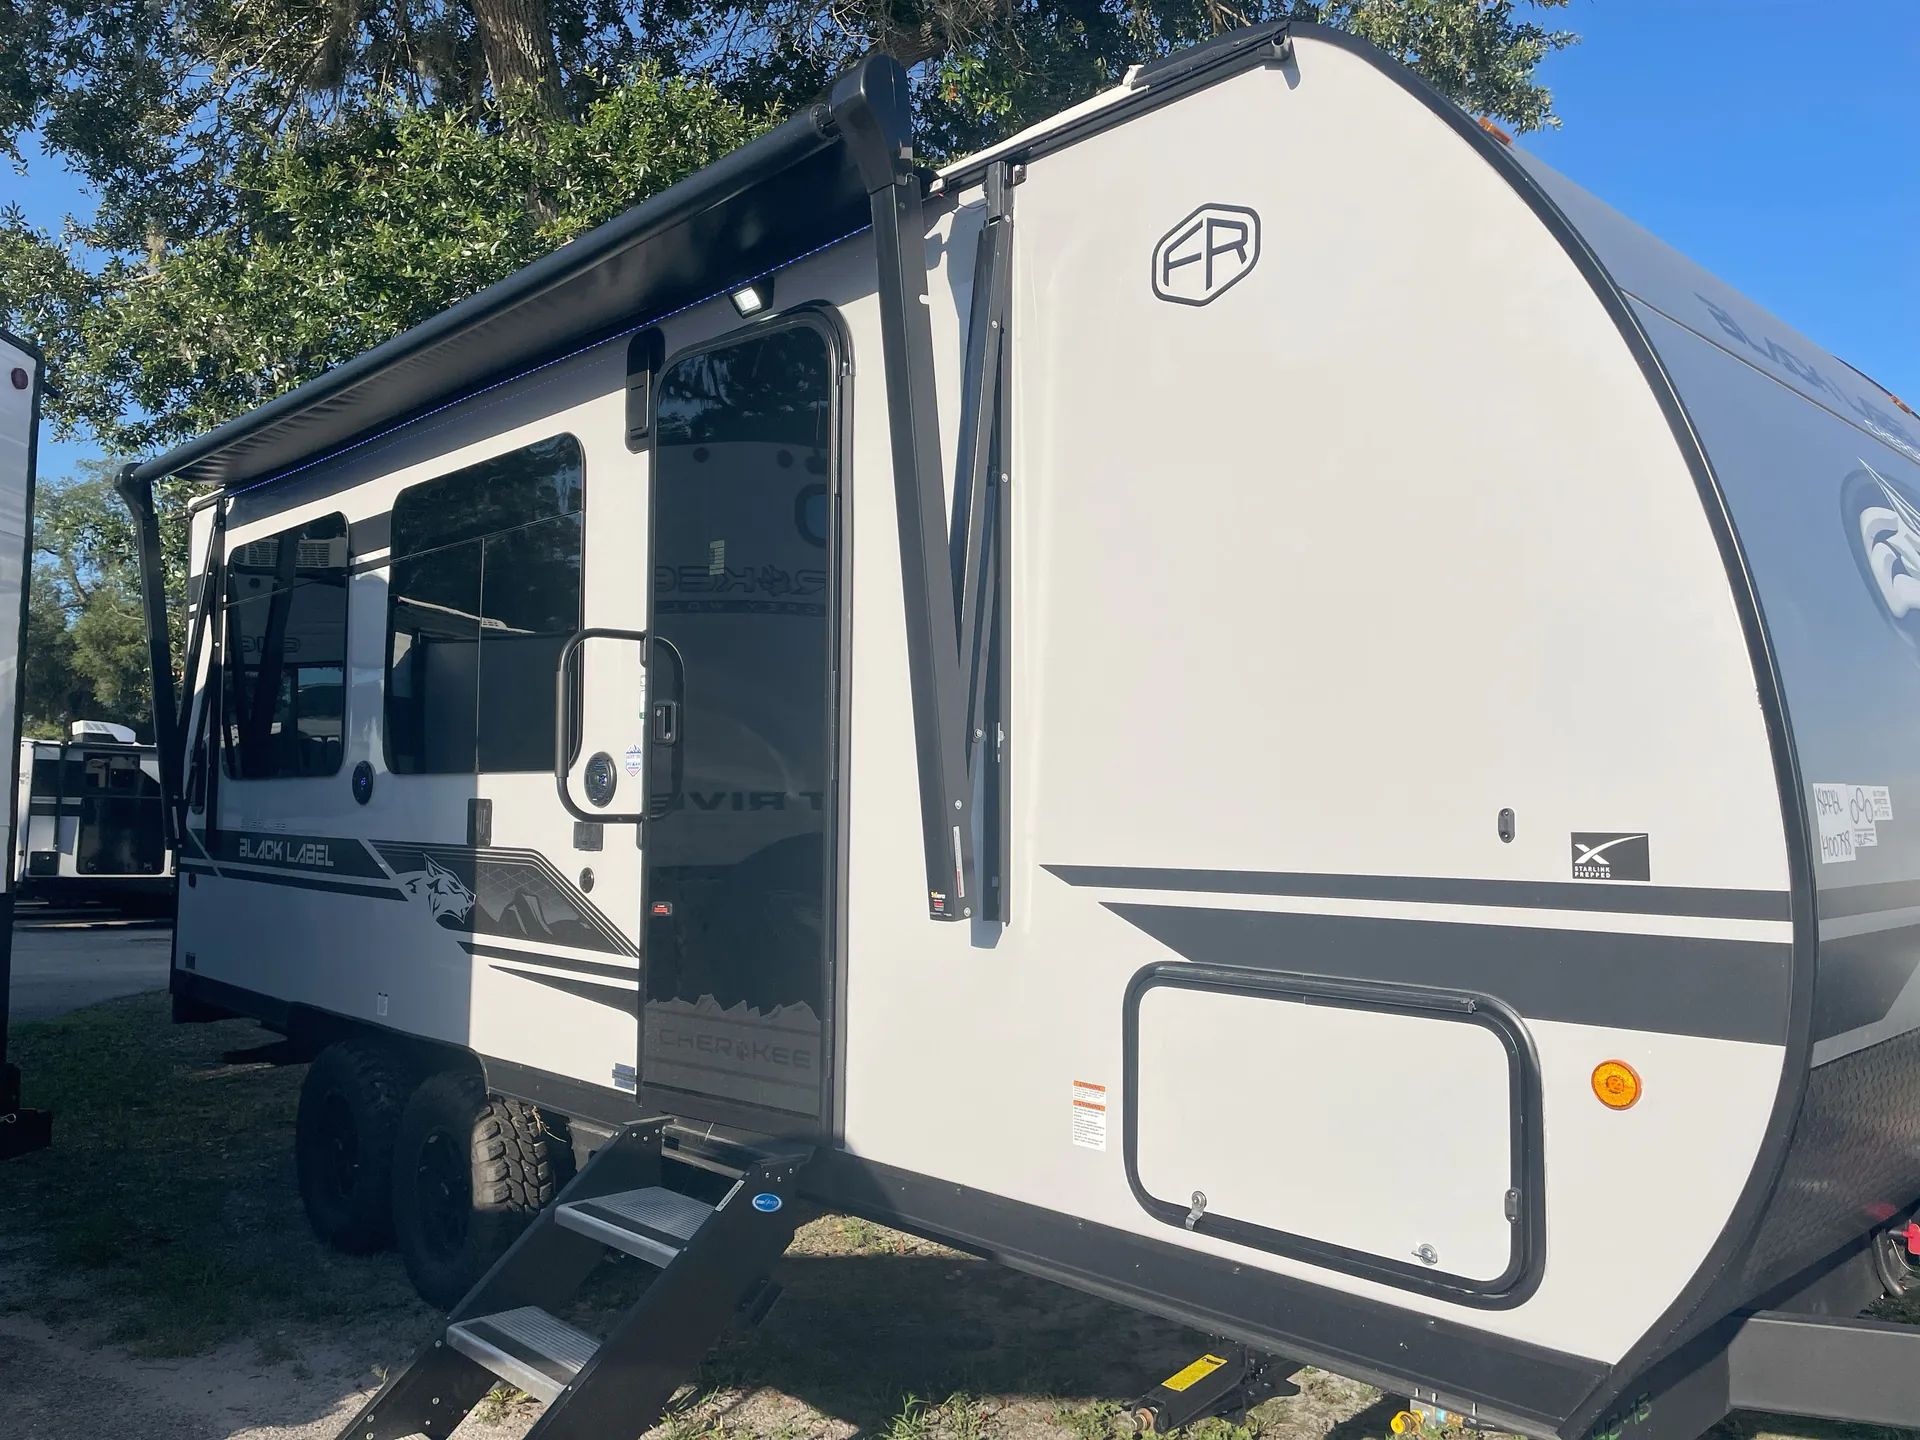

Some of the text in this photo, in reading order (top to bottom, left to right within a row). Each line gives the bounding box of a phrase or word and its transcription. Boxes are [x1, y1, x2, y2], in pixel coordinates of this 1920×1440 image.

[239, 838, 335, 867] BLACK LABEL
[1574, 865, 1611, 873] STARLINK
